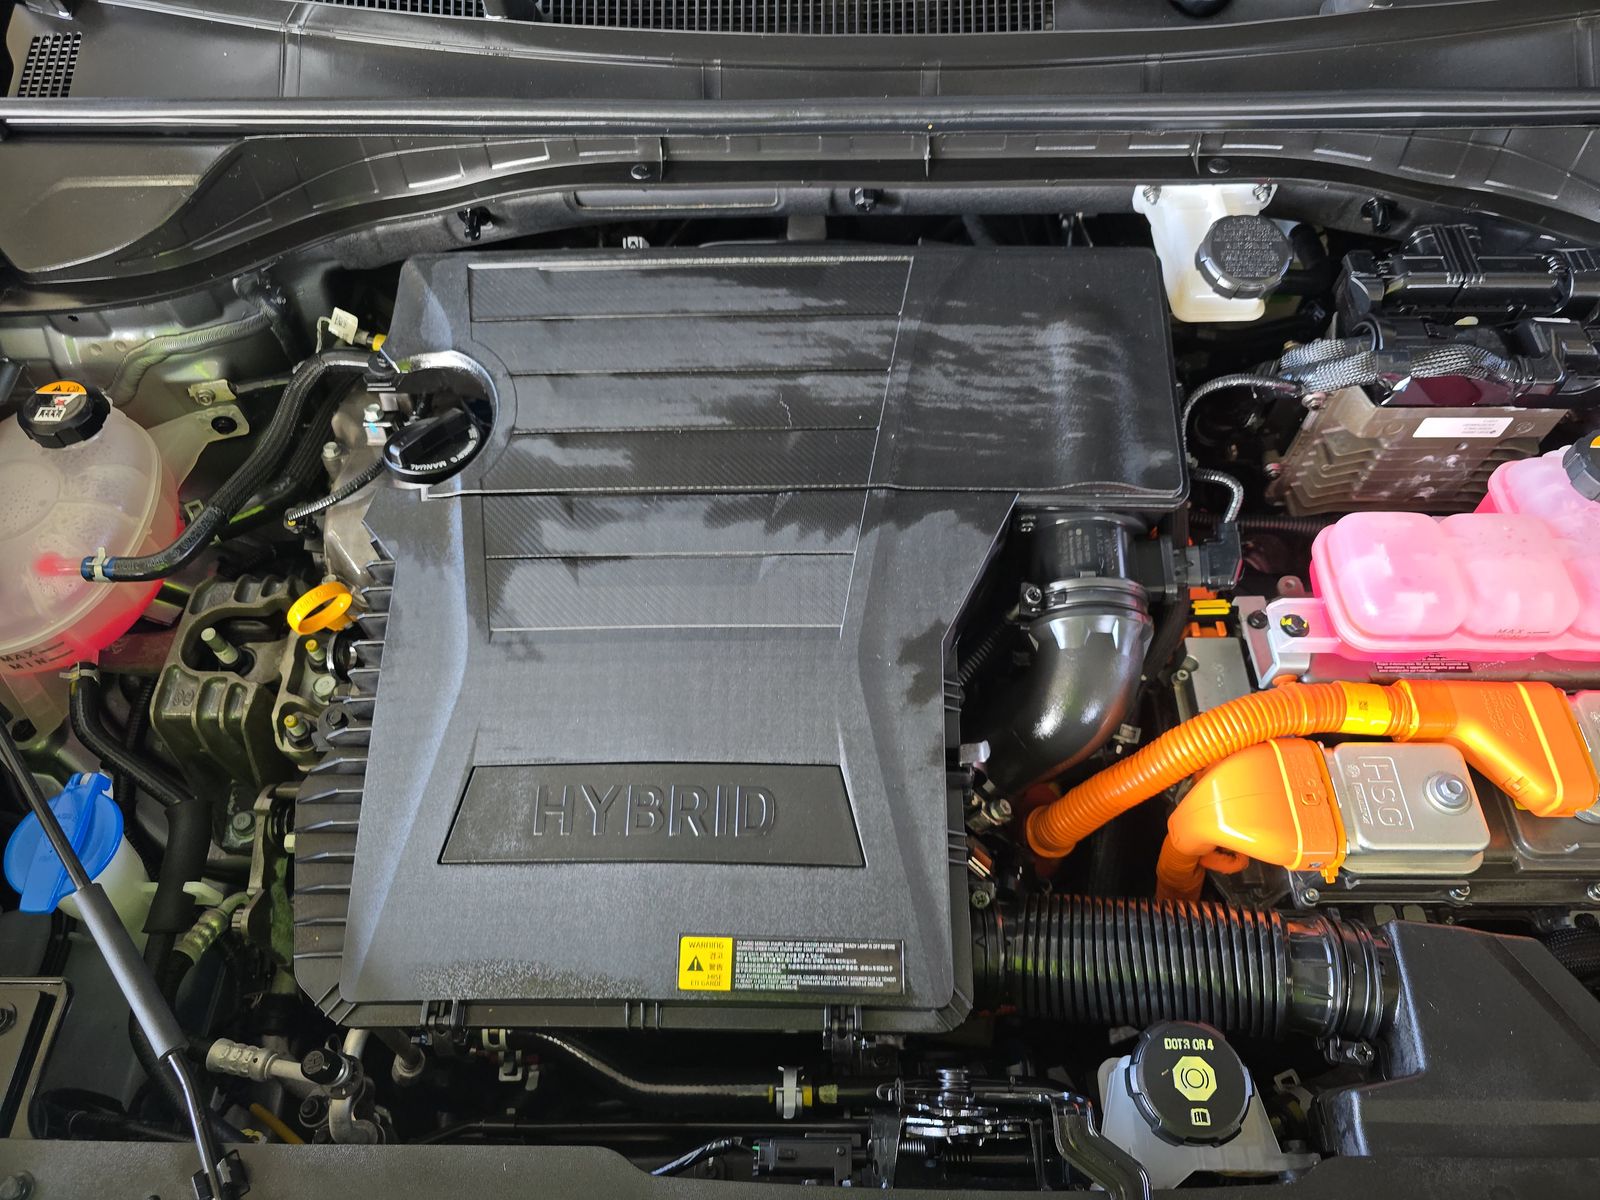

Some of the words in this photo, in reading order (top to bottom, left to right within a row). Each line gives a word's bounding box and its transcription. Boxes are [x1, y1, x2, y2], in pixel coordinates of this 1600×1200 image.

[410, 460, 447, 471] MANUAL
[0, 650, 37, 662] MAX
[8, 657, 48, 670] MIN
[1362, 762, 1403, 826] HSG
[533, 784, 776, 837] HYBRID
[688, 941, 724, 949] WARNING
[1163, 1038, 1190, 1050] DOT3
[1192, 1038, 1206, 1050] OR
[1207, 1038, 1215, 1050] 4
